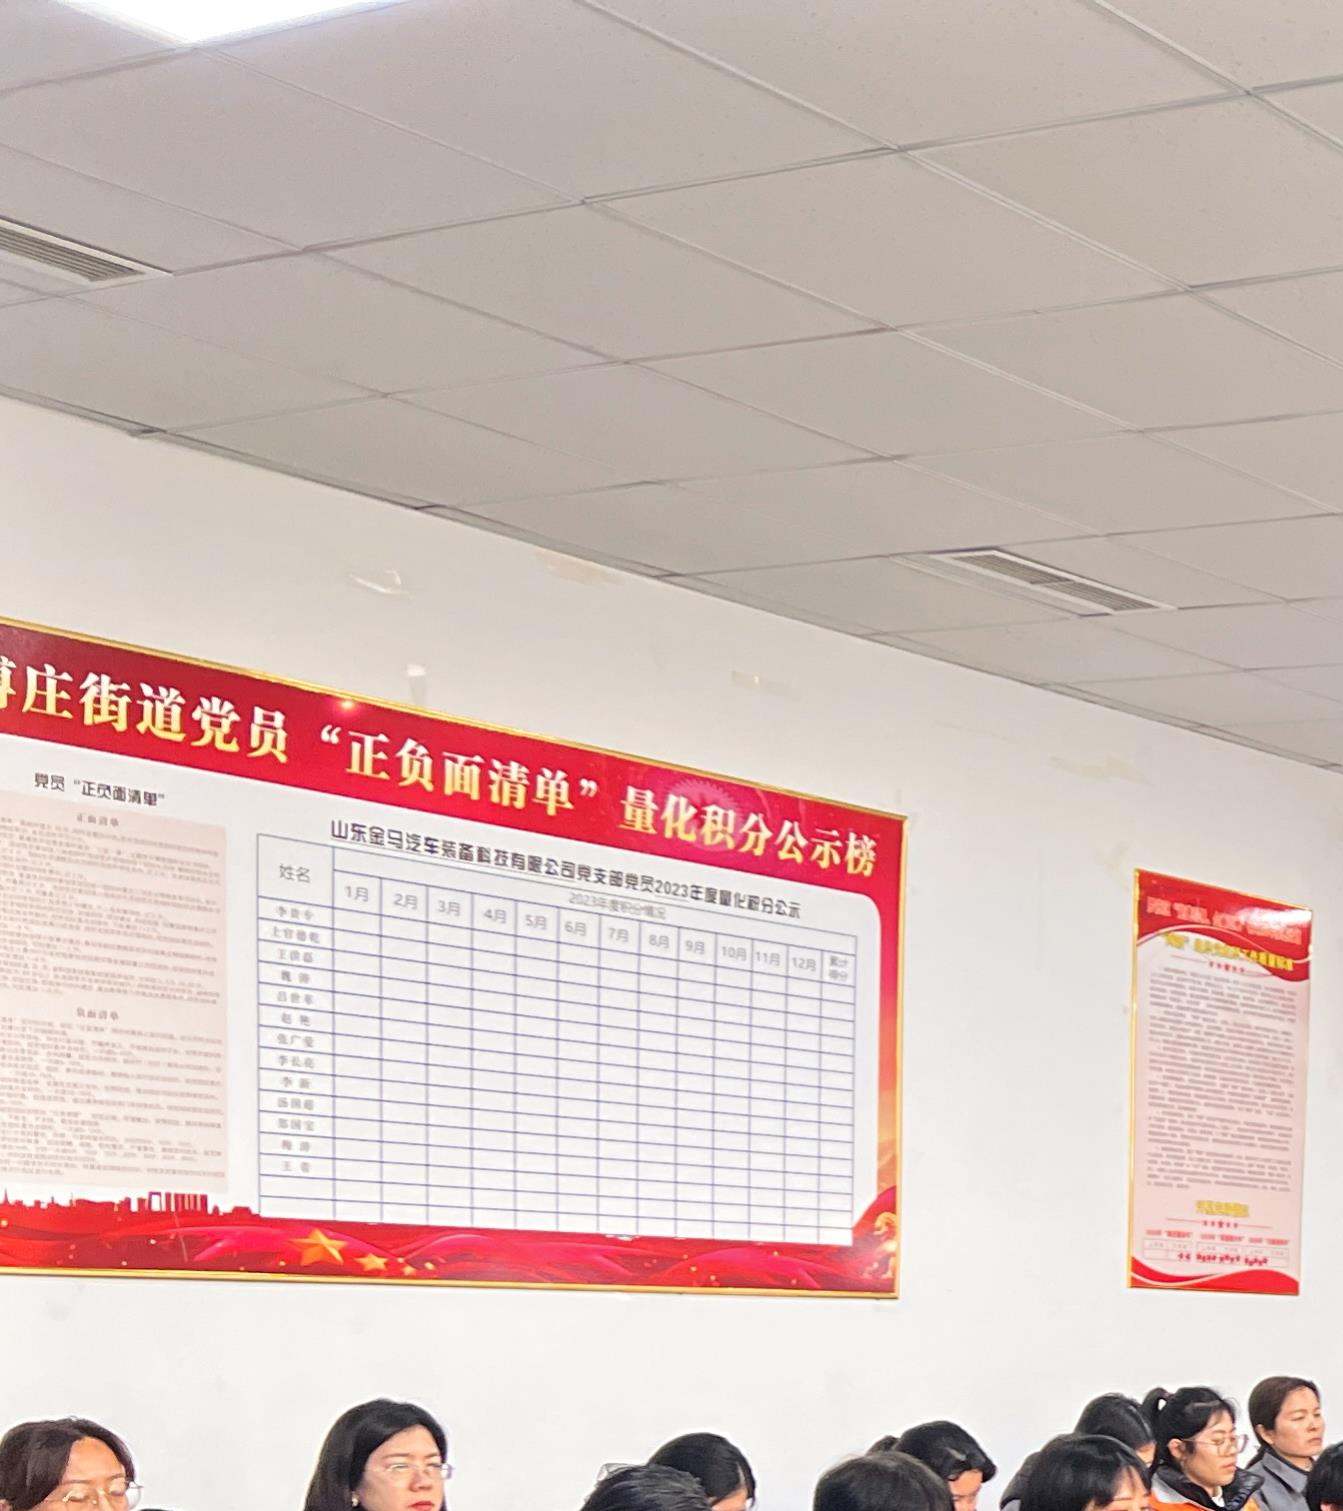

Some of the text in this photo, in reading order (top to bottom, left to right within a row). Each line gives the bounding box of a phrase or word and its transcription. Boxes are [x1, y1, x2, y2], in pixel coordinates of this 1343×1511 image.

[279, 864, 311, 883] 姓名
[345, 886, 369, 902] 1月
[394, 893, 418, 909] 2月
[439, 900, 461, 917] 3月
[483, 908, 507, 924] 4月
[525, 914, 547, 930] 5月
[564, 921, 587, 936] 6月
[608, 928, 629, 942] 7月
[649, 934, 670, 949] 8月
[686, 940, 705, 955] 9月
[722, 946, 747, 961] 10月
[756, 951, 781, 966] 11月
[792, 957, 817, 972] 12月
